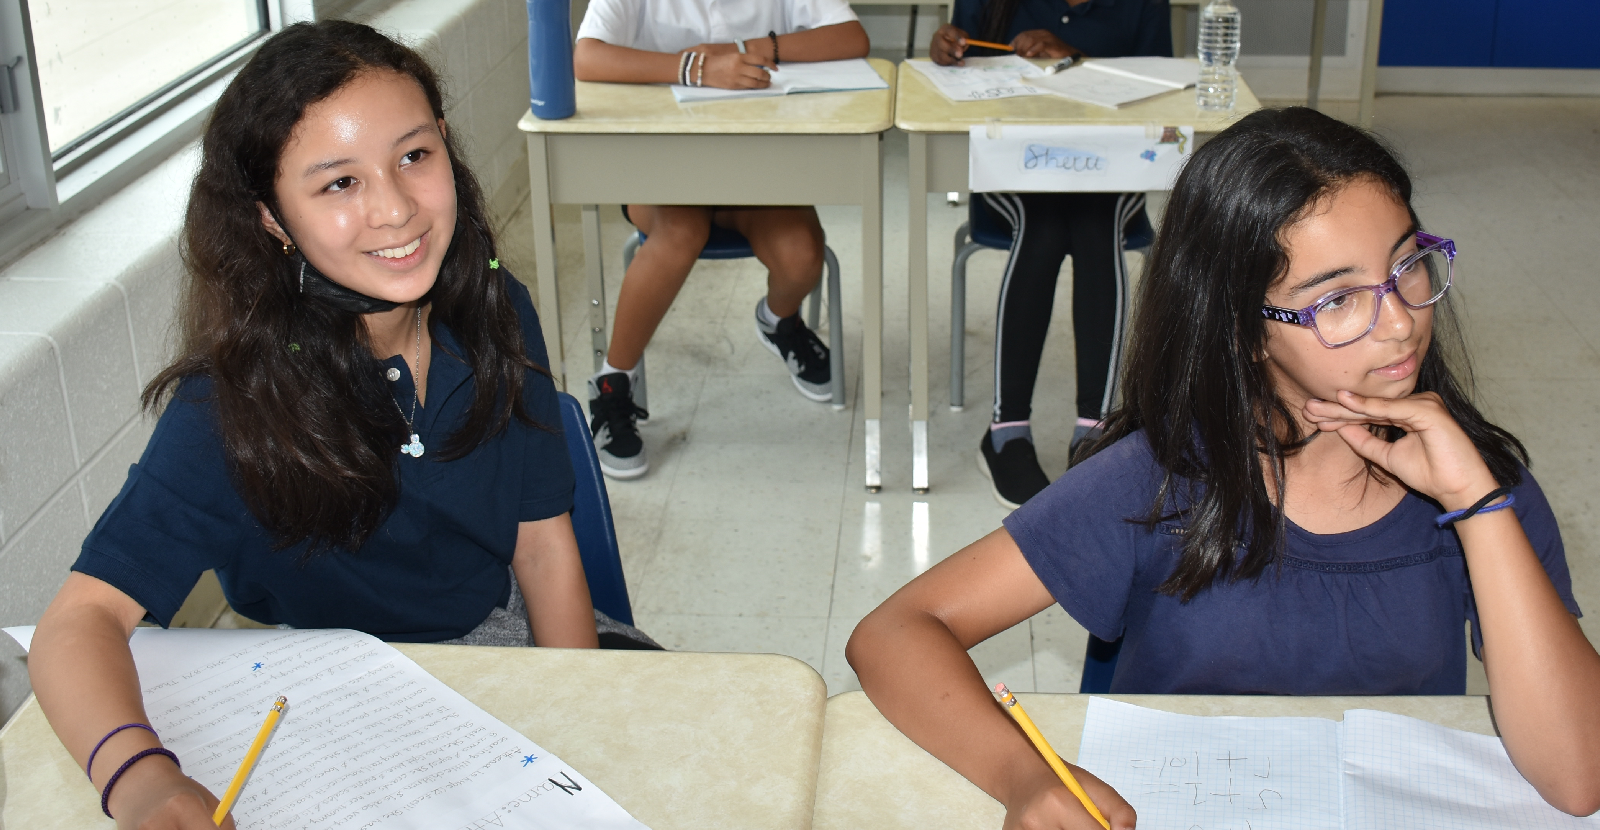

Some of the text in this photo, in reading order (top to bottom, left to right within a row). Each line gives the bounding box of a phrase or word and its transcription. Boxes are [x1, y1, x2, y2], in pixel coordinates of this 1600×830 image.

[384, 712, 403, 722] She
[453, 721, 474, 731] She
[481, 745, 522, 769] Athena
[409, 765, 429, 774] She
[501, 769, 579, 811] Name:
[296, 794, 314, 804] has
[349, 795, 365, 805] her
[361, 800, 383, 811] also
[268, 803, 296, 819] silver
[300, 806, 314, 819] is
[382, 809, 404, 819] She
[333, 811, 360, 826] very
